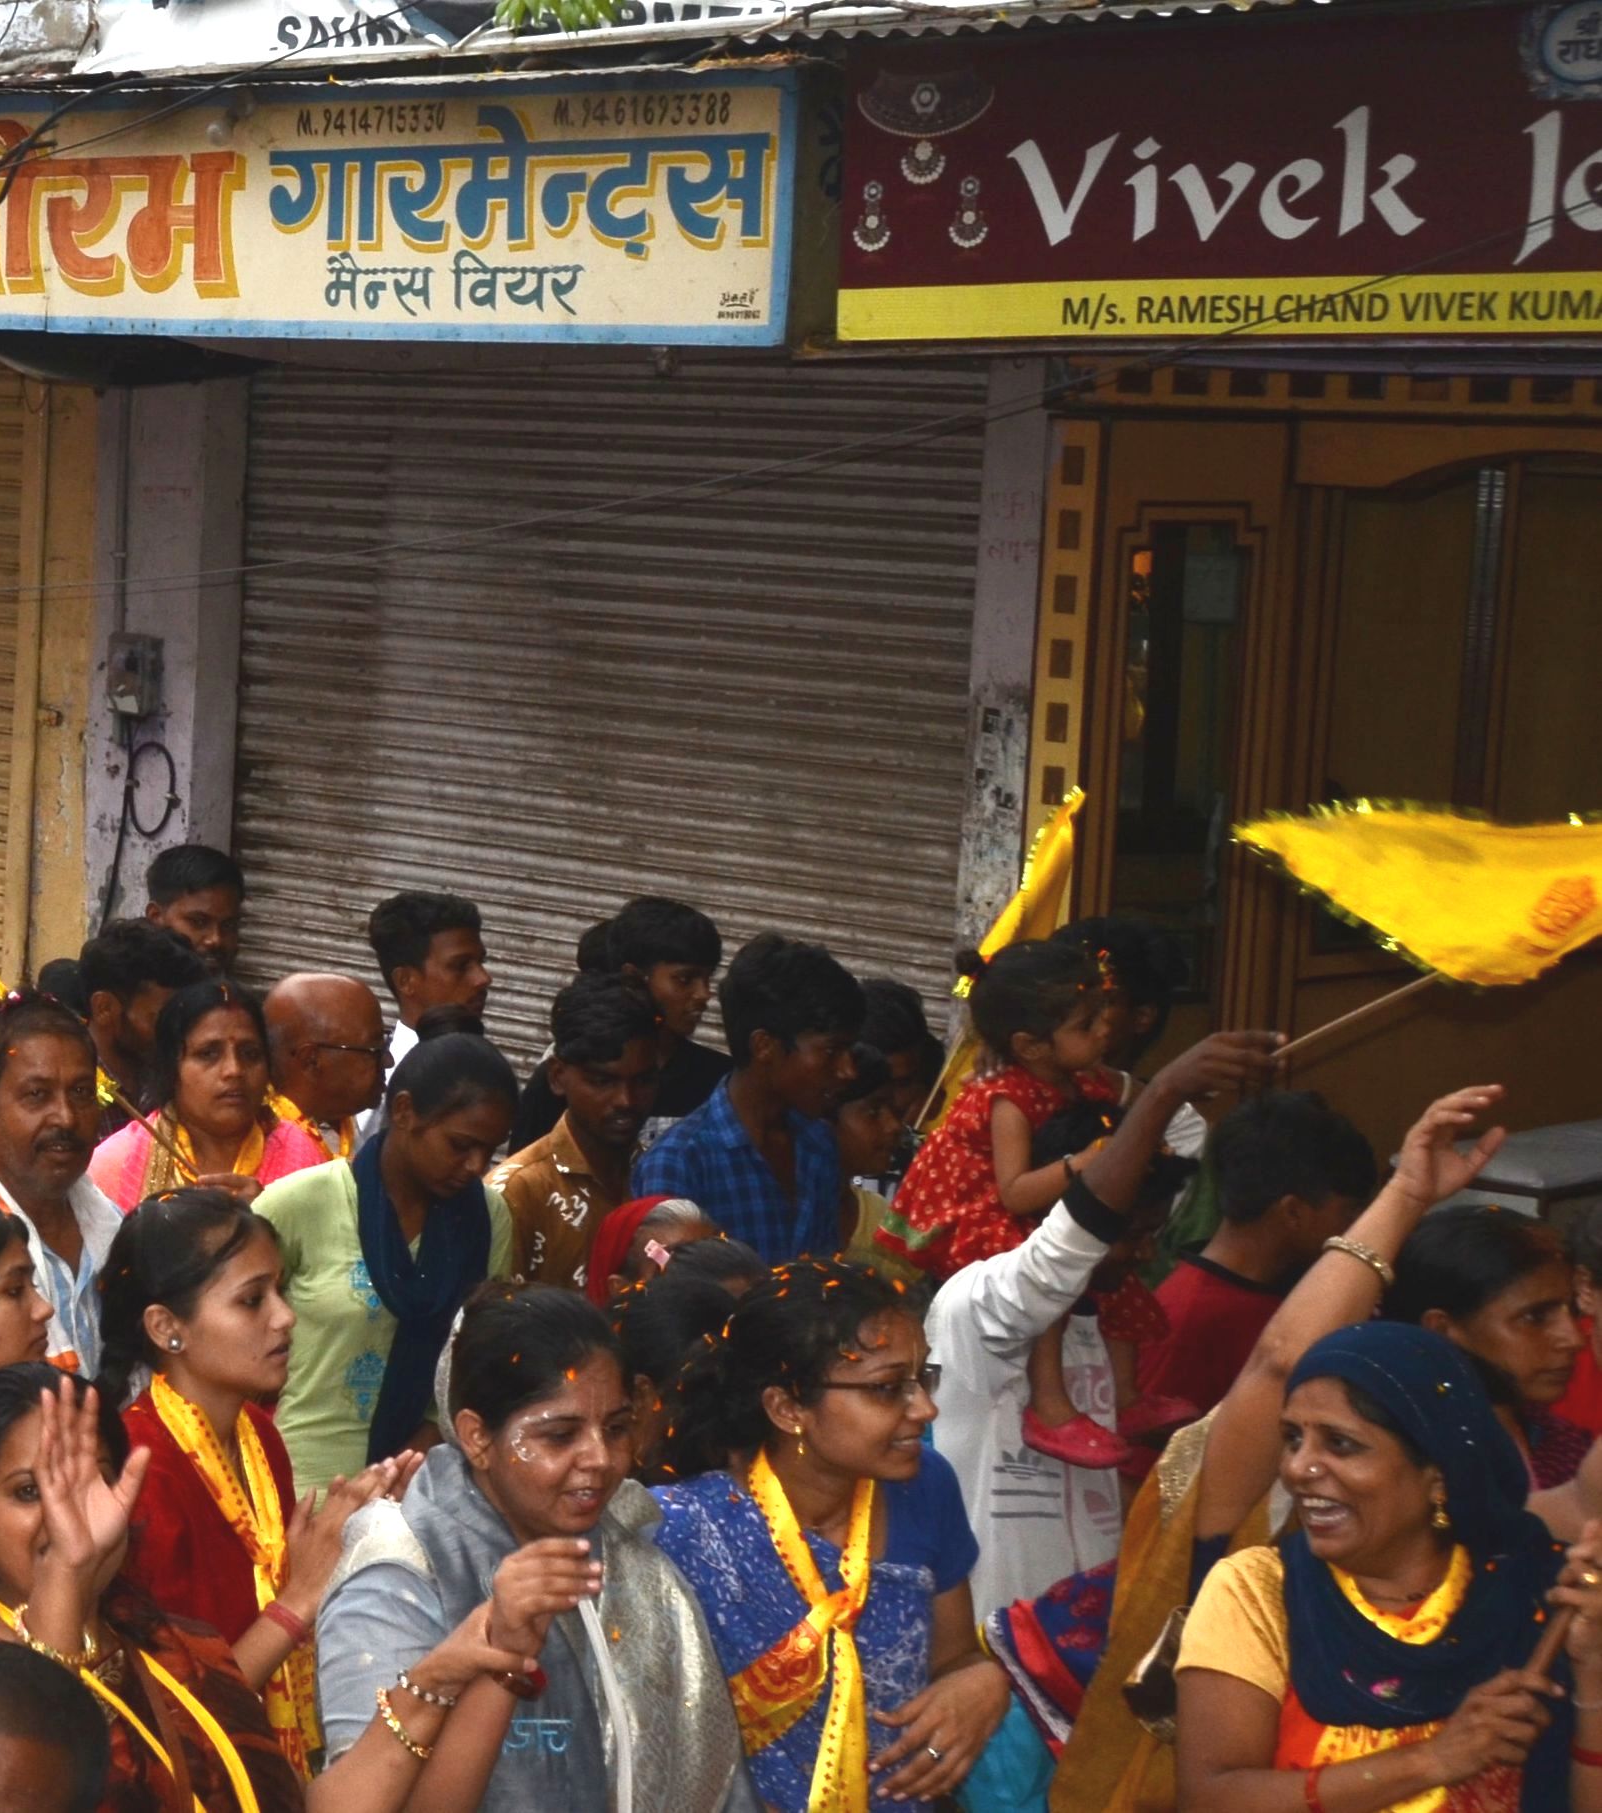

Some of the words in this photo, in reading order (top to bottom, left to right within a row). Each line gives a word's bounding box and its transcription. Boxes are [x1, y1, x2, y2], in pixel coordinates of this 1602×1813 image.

[1007, 105, 1427, 247] Vivek
[1512, 110, 1602, 266] Je
[453, 253, 585, 317] वियर
[1062, 294, 1127, 331] M/s.
[1136, 294, 1266, 327] RAMESH
[1275, 292, 1390, 324] CHAND
[1400, 290, 1500, 322] VIVEK
